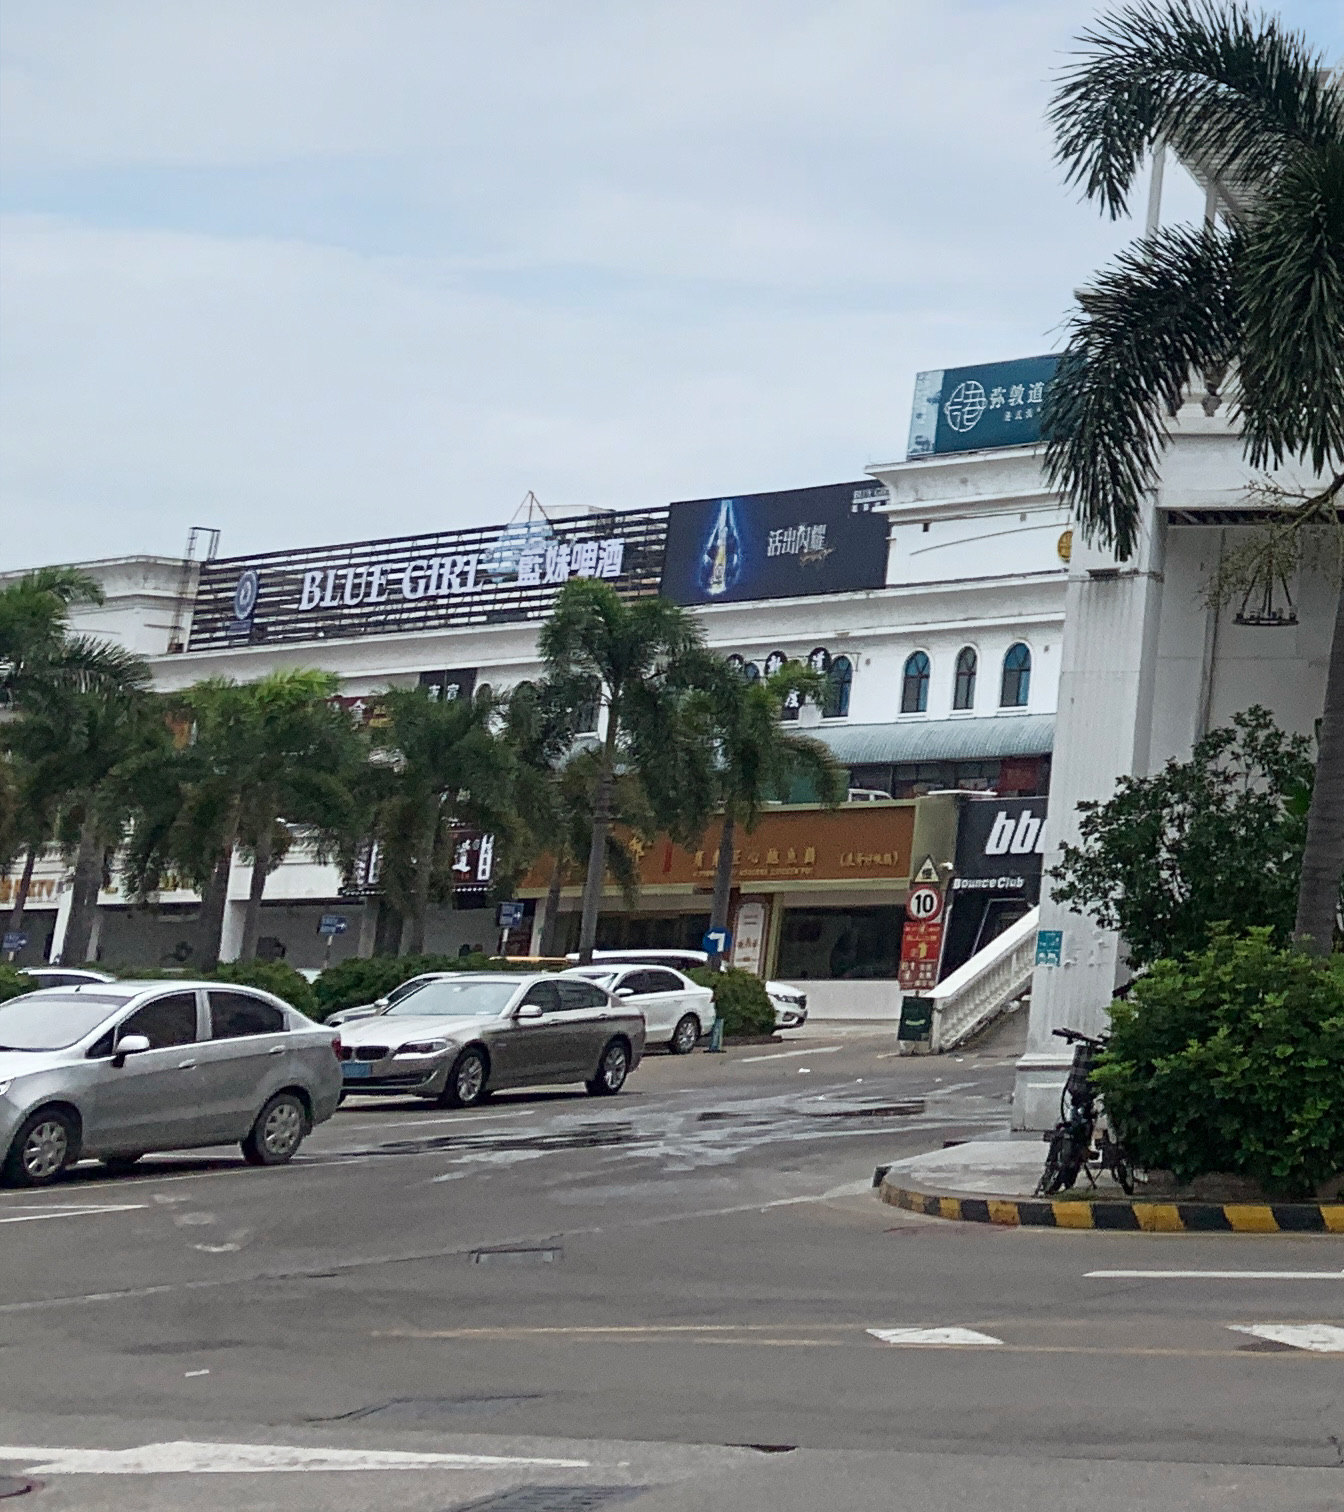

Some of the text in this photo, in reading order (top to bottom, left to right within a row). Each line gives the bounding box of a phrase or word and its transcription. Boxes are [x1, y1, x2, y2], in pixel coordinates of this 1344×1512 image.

[298, 552, 486, 611] BLUE GIRL
[997, 876, 1025, 889] Club
[915, 894, 934, 914] 10
